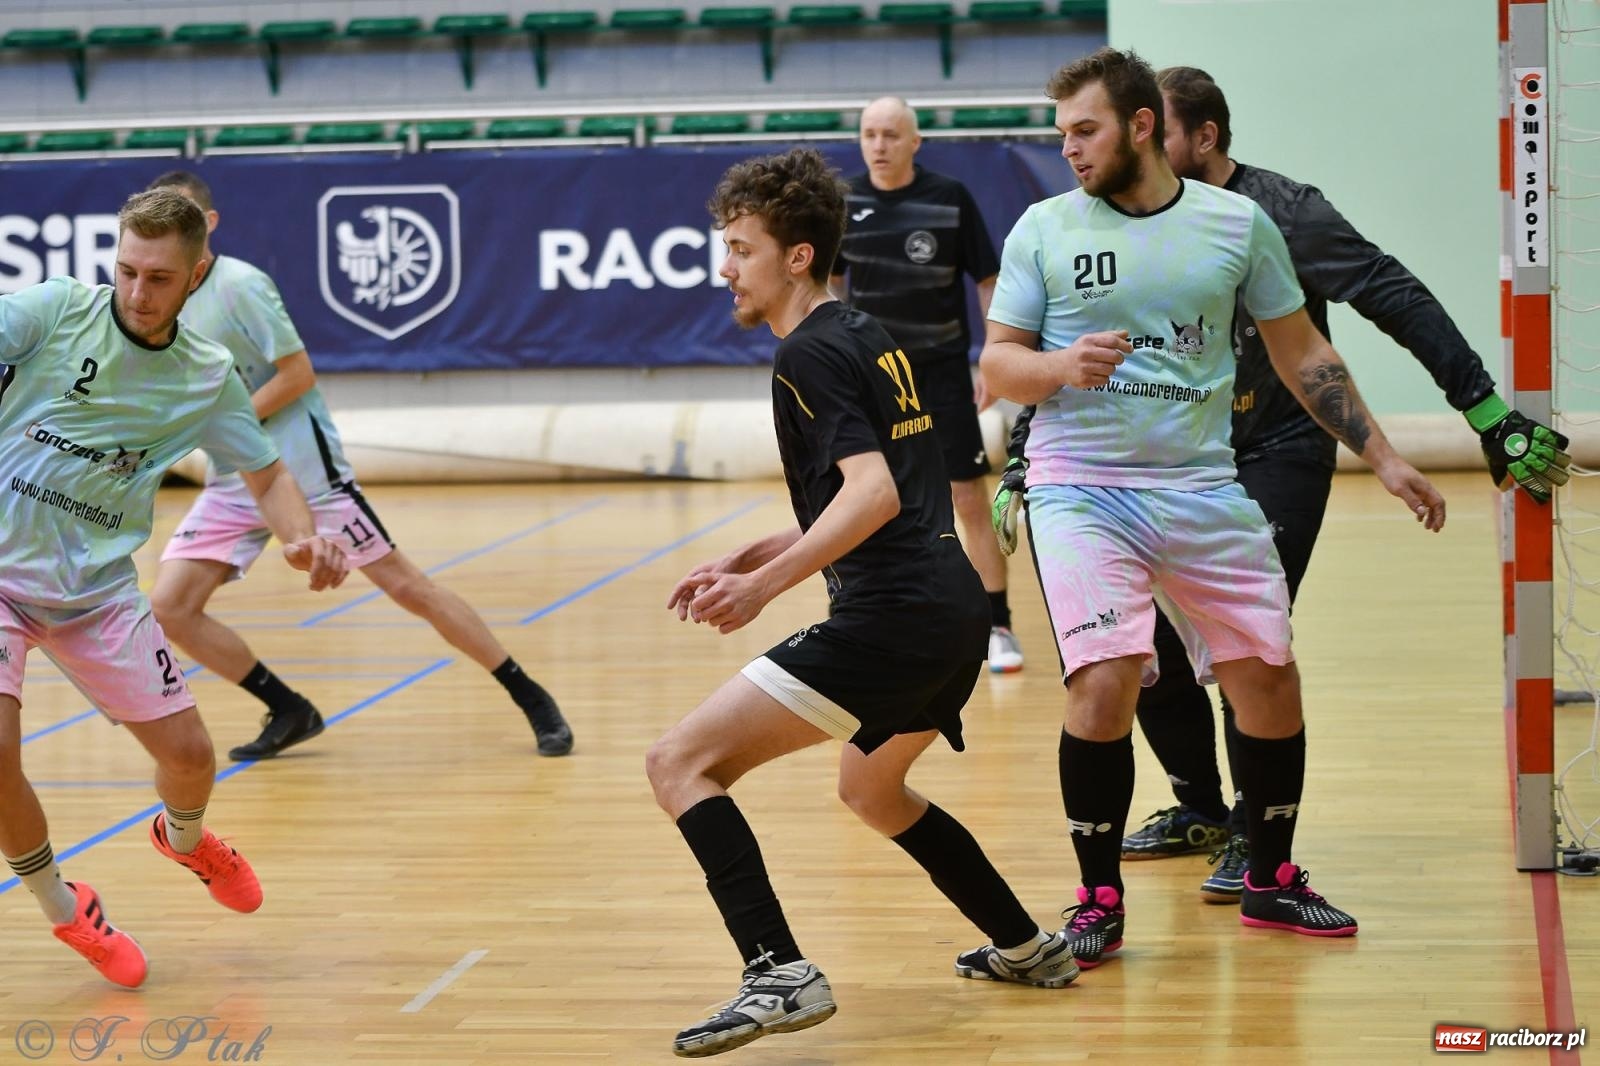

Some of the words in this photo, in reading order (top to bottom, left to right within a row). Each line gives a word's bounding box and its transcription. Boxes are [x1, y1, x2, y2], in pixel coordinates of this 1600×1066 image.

[1074, 251, 1117, 290] 20
[73, 357, 98, 396] 2
[25, 422, 106, 463] Concrete
[11, 476, 124, 531] www.concretedm.pl
[342, 518, 375, 547] 11
[1062, 621, 1097, 641] Concrete
[155, 648, 178, 686] 2
